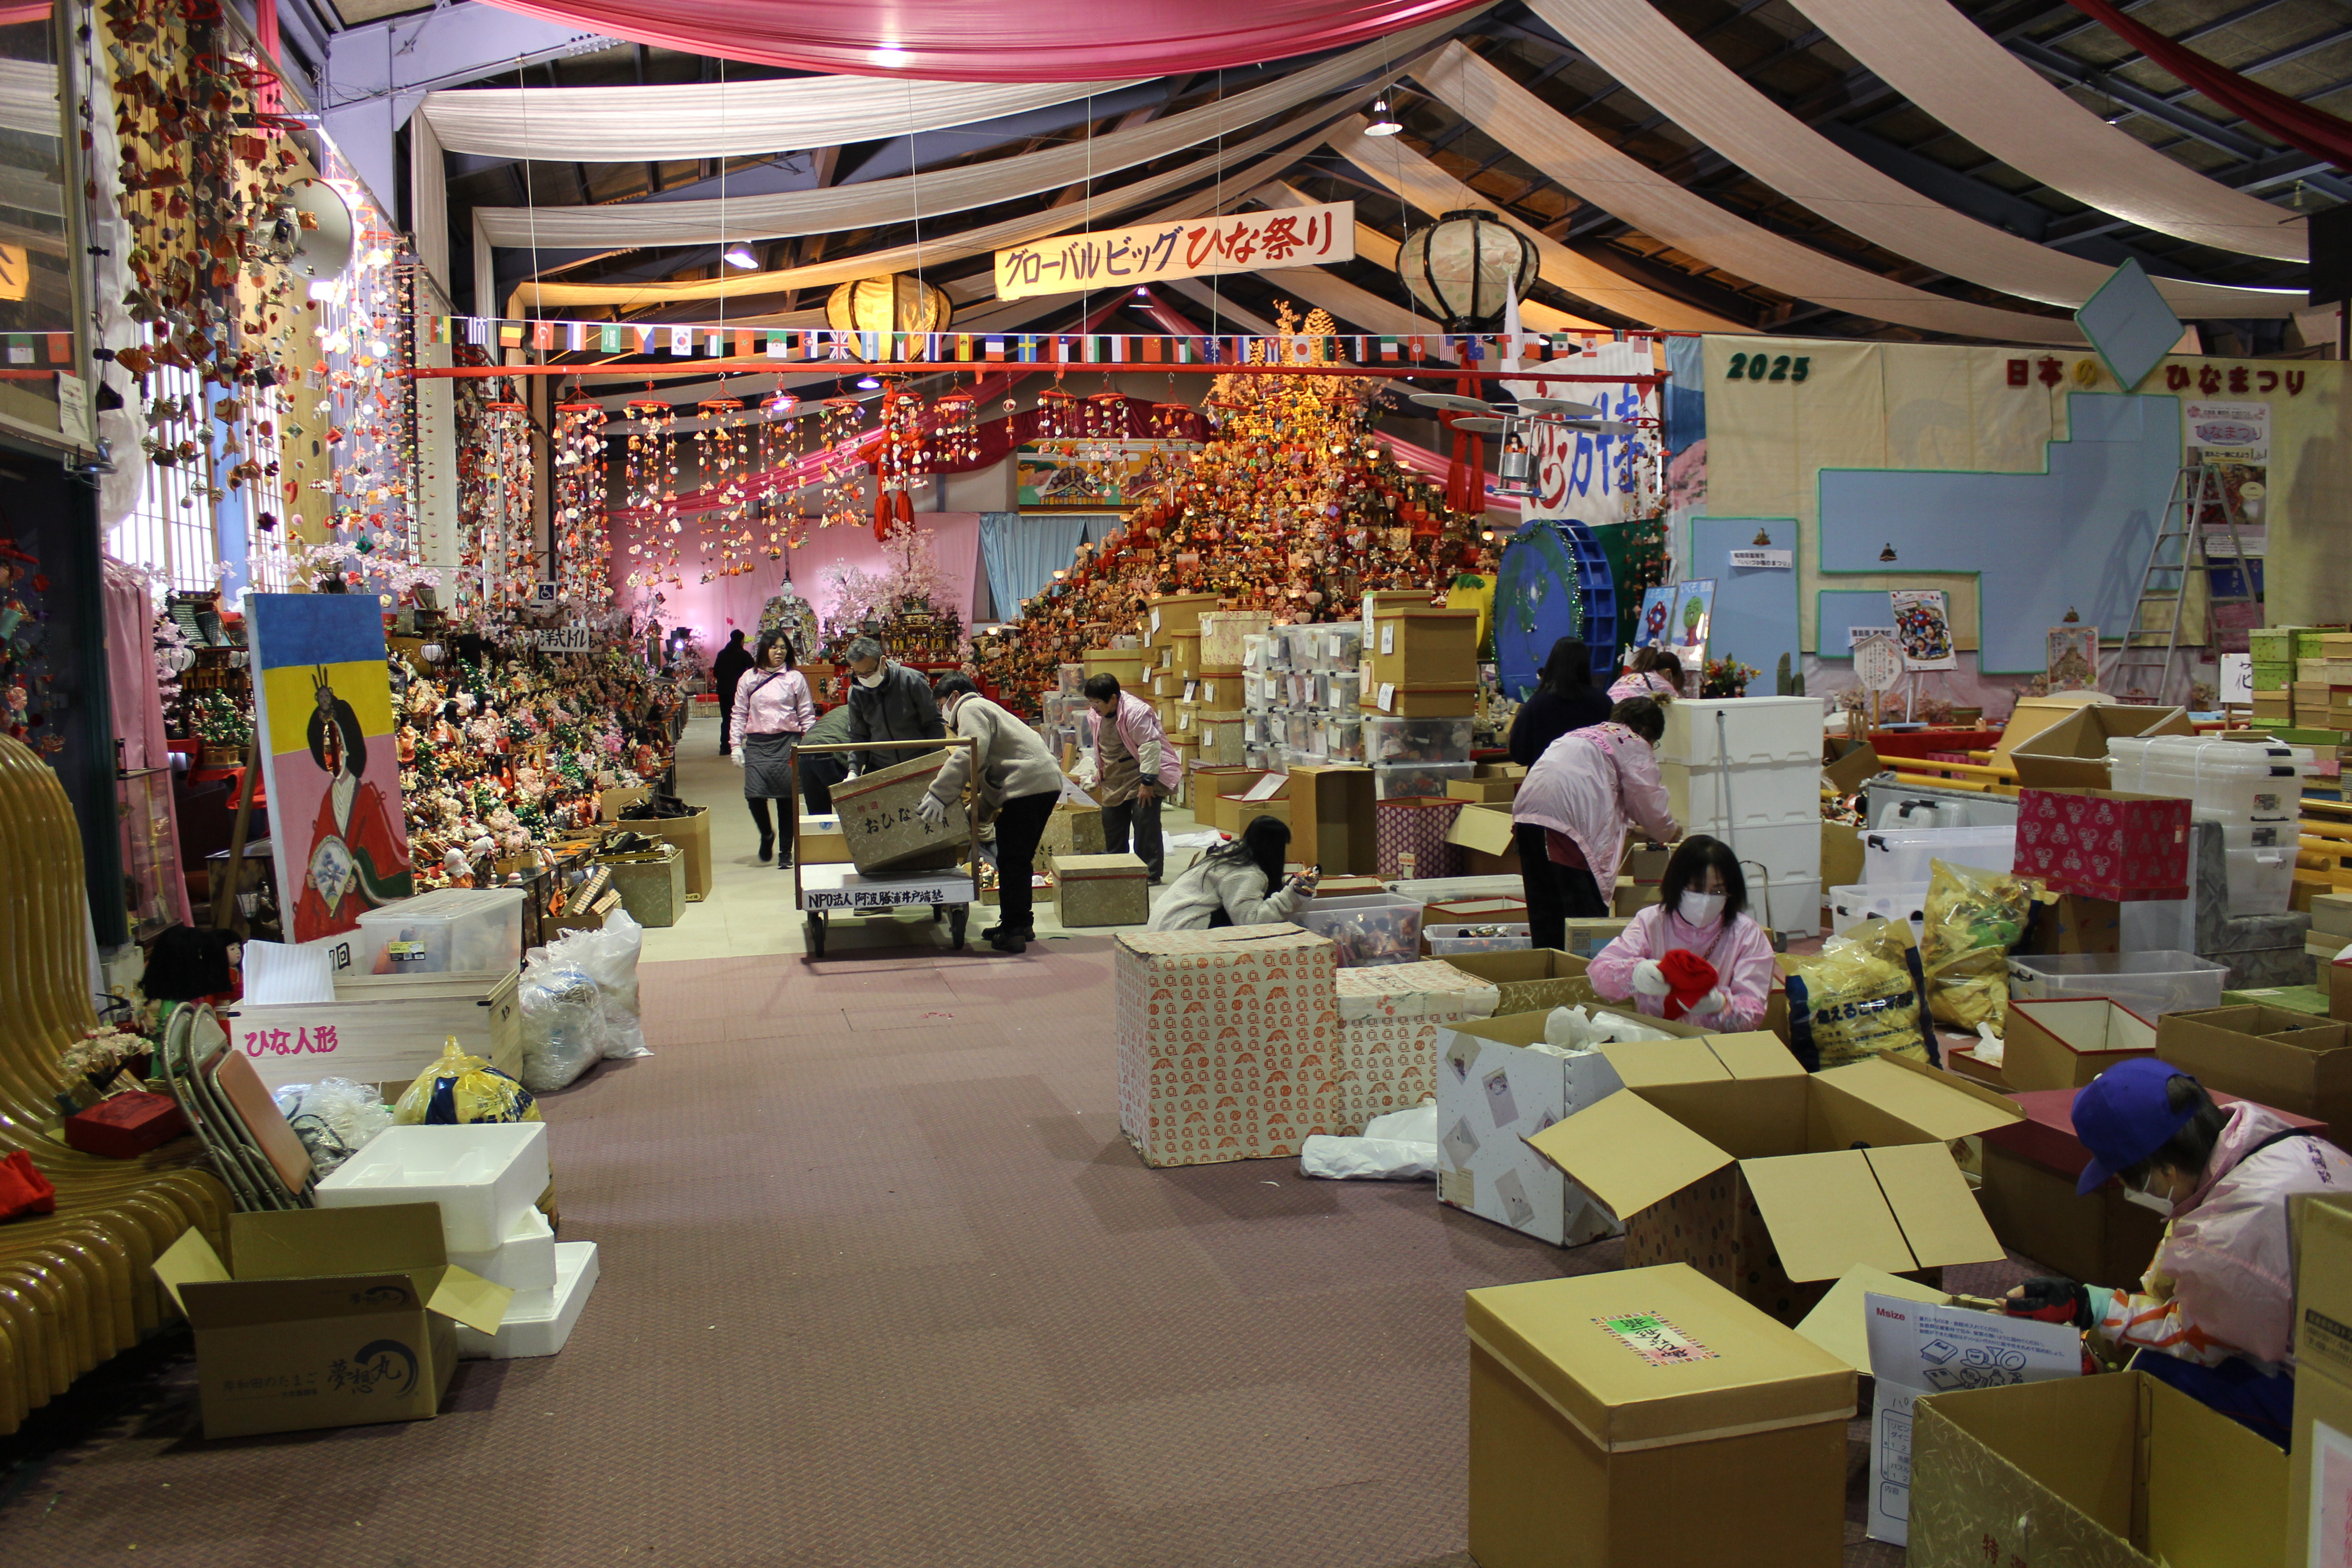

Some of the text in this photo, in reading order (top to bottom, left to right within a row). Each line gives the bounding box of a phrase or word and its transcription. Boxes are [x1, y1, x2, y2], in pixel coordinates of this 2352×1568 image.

[1004, 211, 1333, 287] グローバルビッグひな祭り
[1726, 353, 1810, 382] 2025
[2007, 357, 2305, 396] 日本の ひなまつり
[2195, 425, 2262, 440] ひなまつり
[539, 629, 587, 648] 洋式トイレ
[808, 889, 944, 908] NPO法人 阿波勝浦井戸端塾
[245, 1025, 338, 1057] ひな人形
[1876, 1307, 1906, 1321] Msize
[327, 1355, 402, 1395] 夢想丸
[1891, 1423, 1912, 1433] リビン
[1884, 1486, 1899, 1495] 内容
